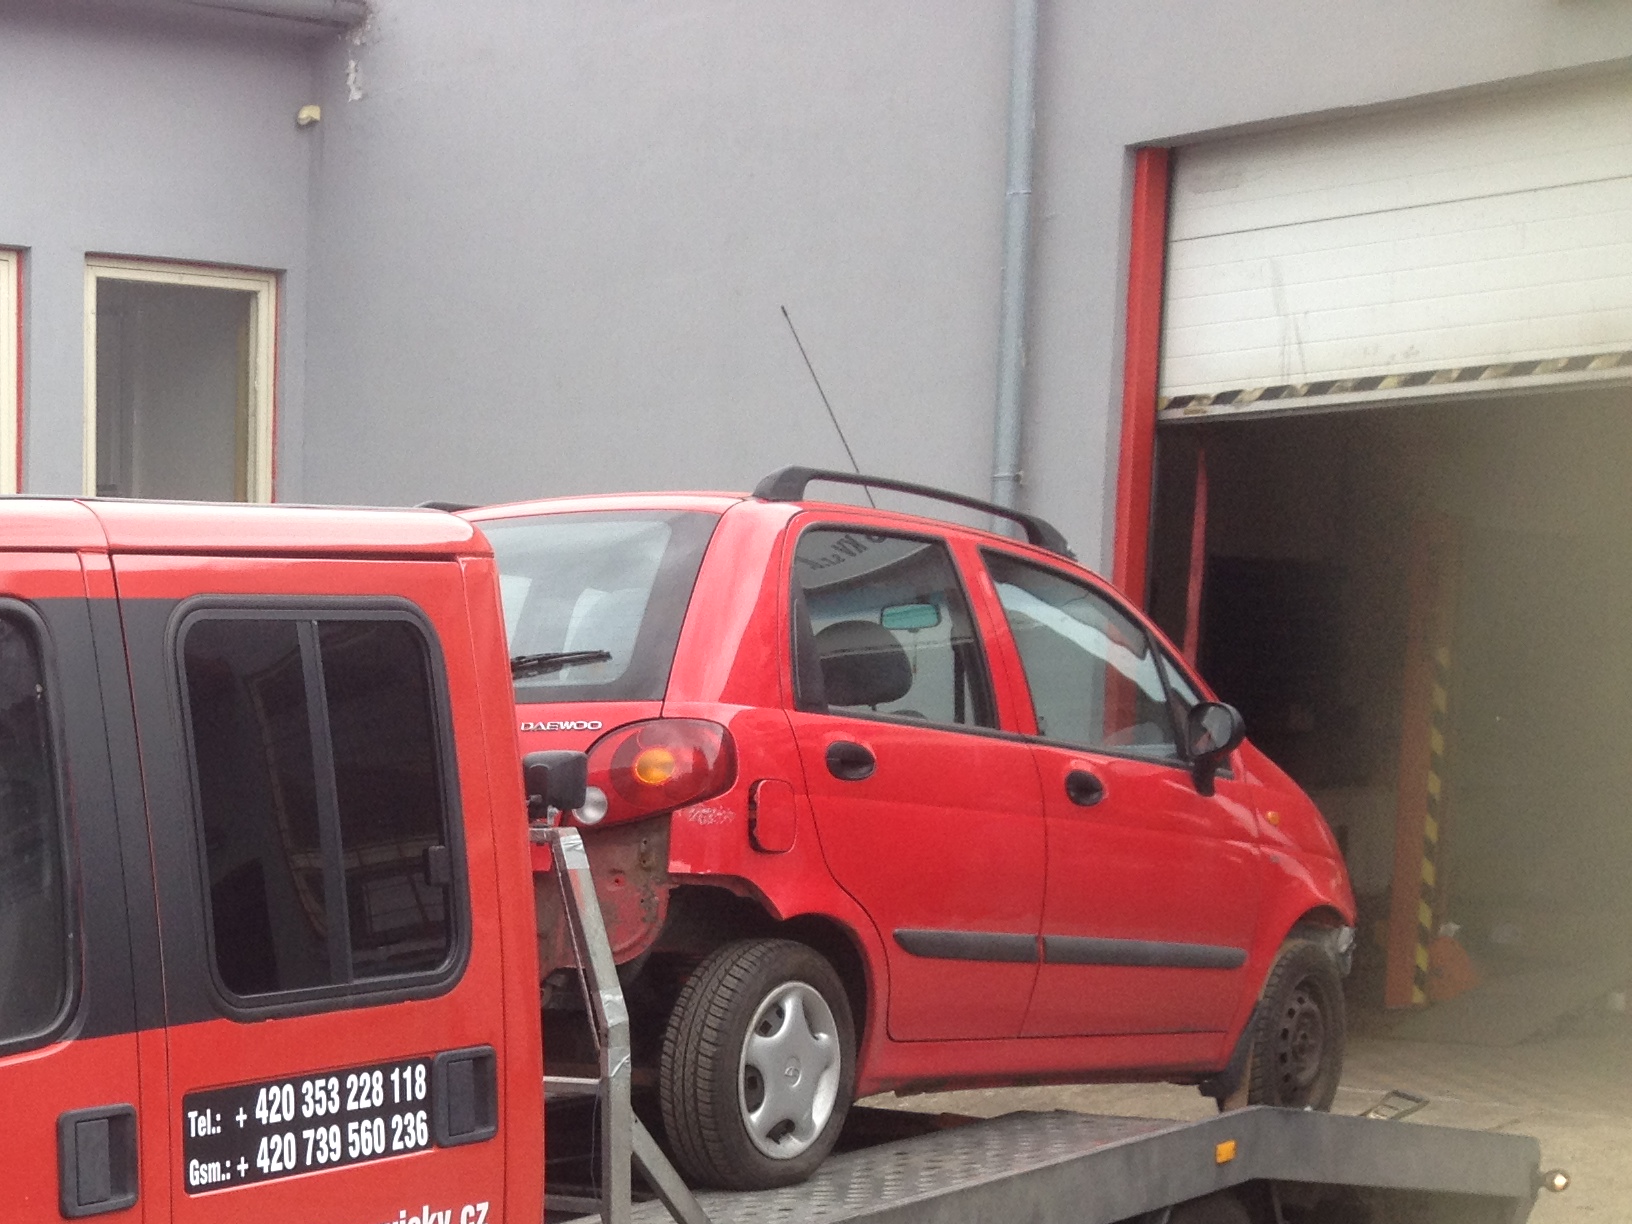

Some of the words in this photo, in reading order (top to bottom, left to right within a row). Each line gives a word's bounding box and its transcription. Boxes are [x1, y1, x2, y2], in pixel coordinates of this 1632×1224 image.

[521, 720, 603, 731] DAEWOO
[188, 1110, 221, 1138] Tel.:
[235, 1107, 248, 1128] +
[255, 1083, 295, 1124] 420
[302, 1076, 340, 1118] 353
[346, 1070, 383, 1110] 228
[390, 1064, 426, 1103] 118
[189, 1159, 231, 1186] Gsm.:
[237, 1156, 249, 1178] +
[256, 1133, 296, 1174] 420
[303, 1125, 341, 1166] 739
[348, 1117, 385, 1157] 560
[391, 1110, 428, 1150] 236
